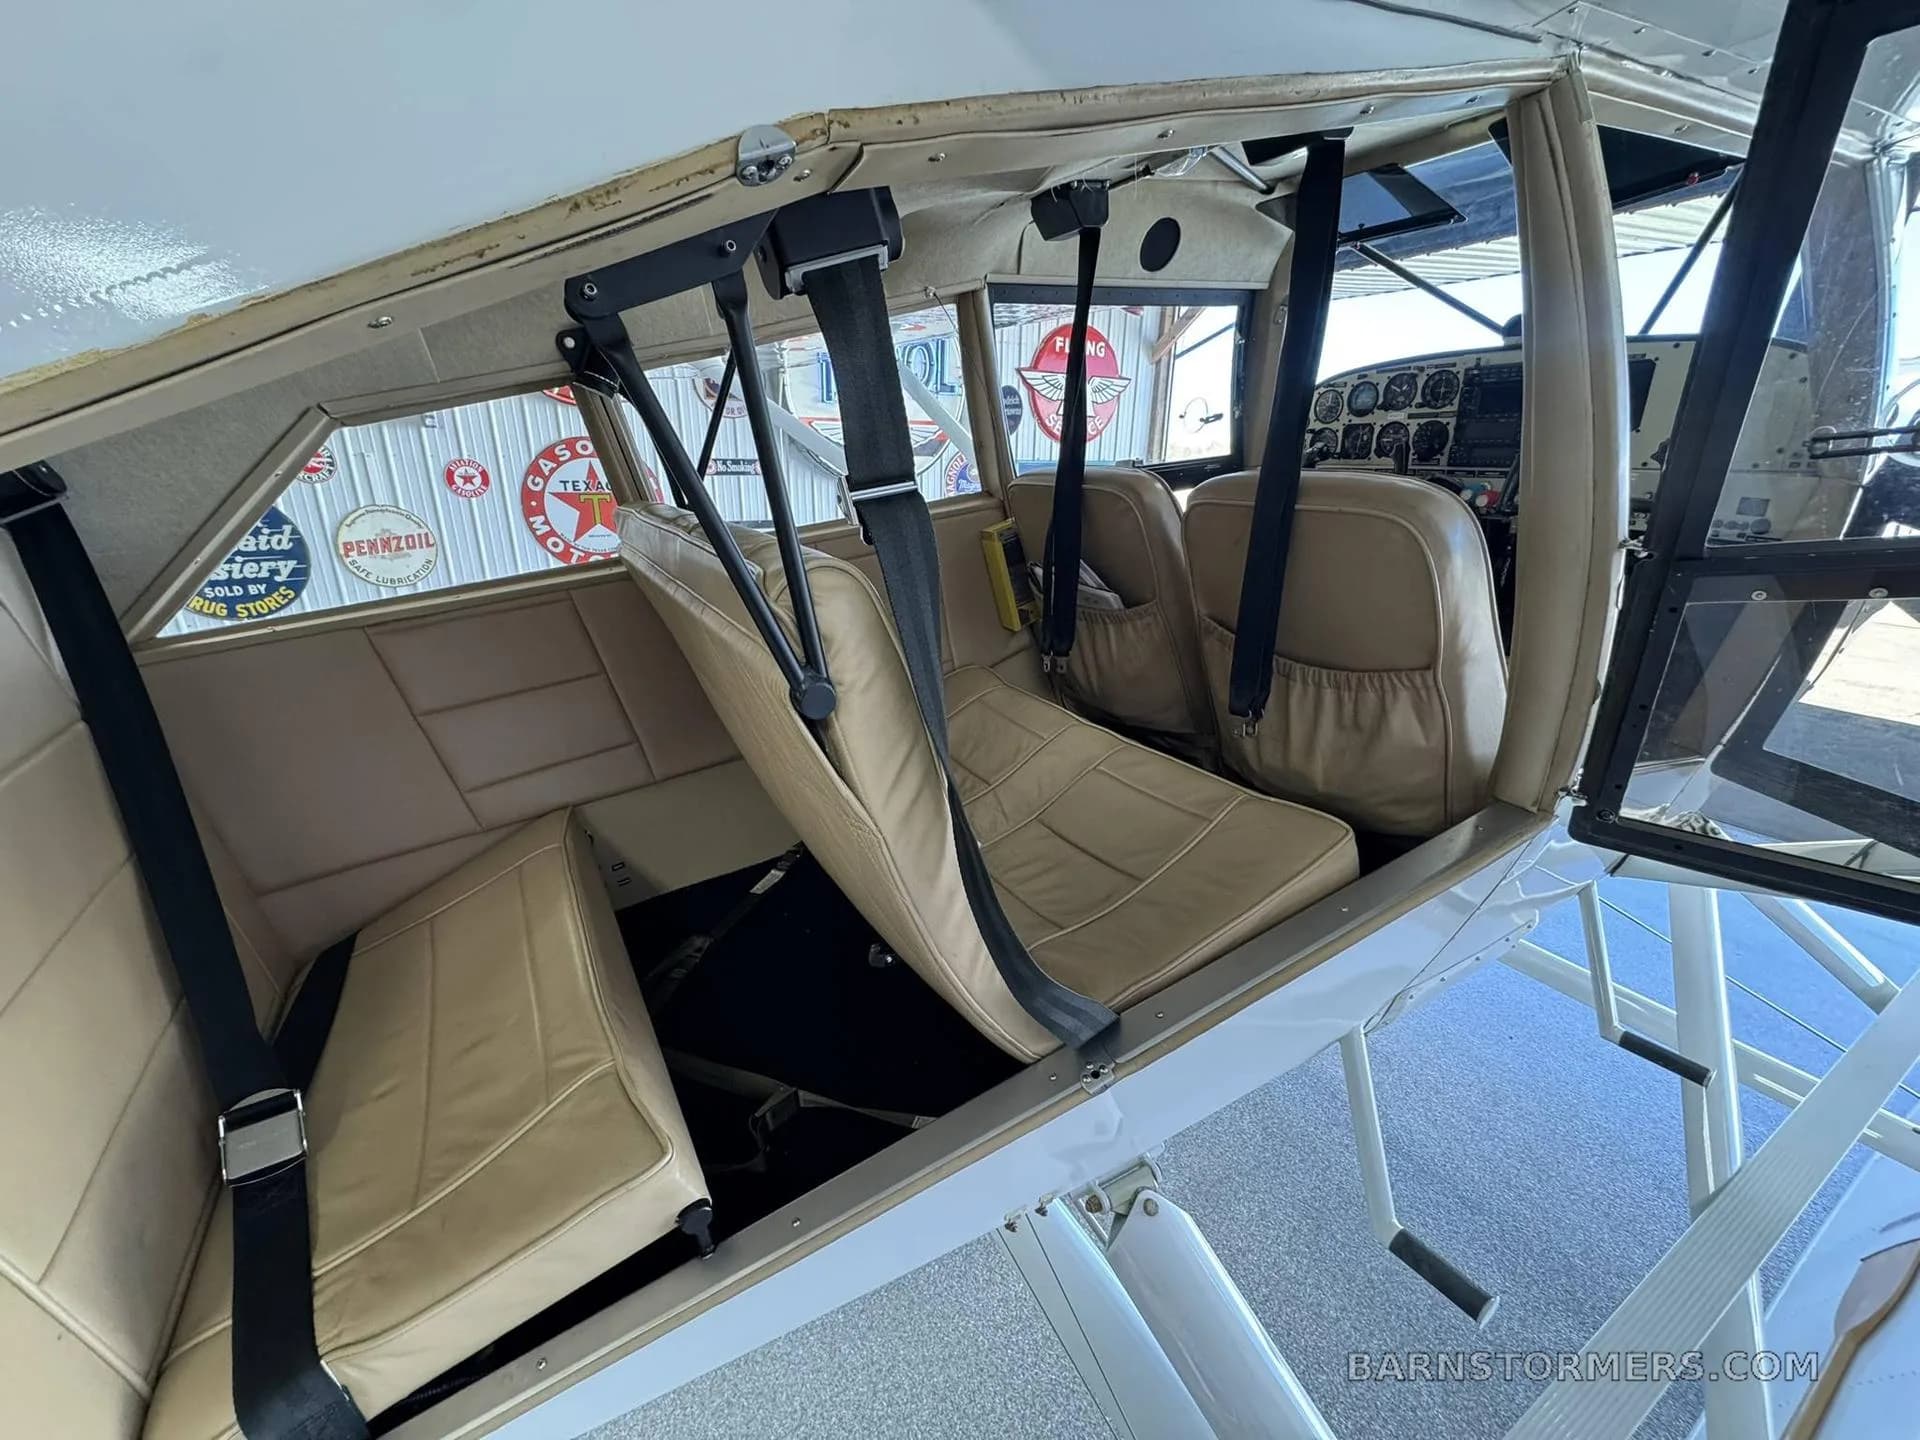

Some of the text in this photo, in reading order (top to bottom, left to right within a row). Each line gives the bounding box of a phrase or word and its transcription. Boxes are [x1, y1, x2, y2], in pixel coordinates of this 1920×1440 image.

[527, 439, 594, 491] GASO
[559, 480, 613, 492] TEXAC
[342, 532, 435, 558] PENNZOIL
[209, 555, 298, 581] siery
[348, 558, 433, 585] SAFE LUBRICATION
[188, 586, 296, 618] RUG STORES
[203, 583, 267, 599] SOLD BY
